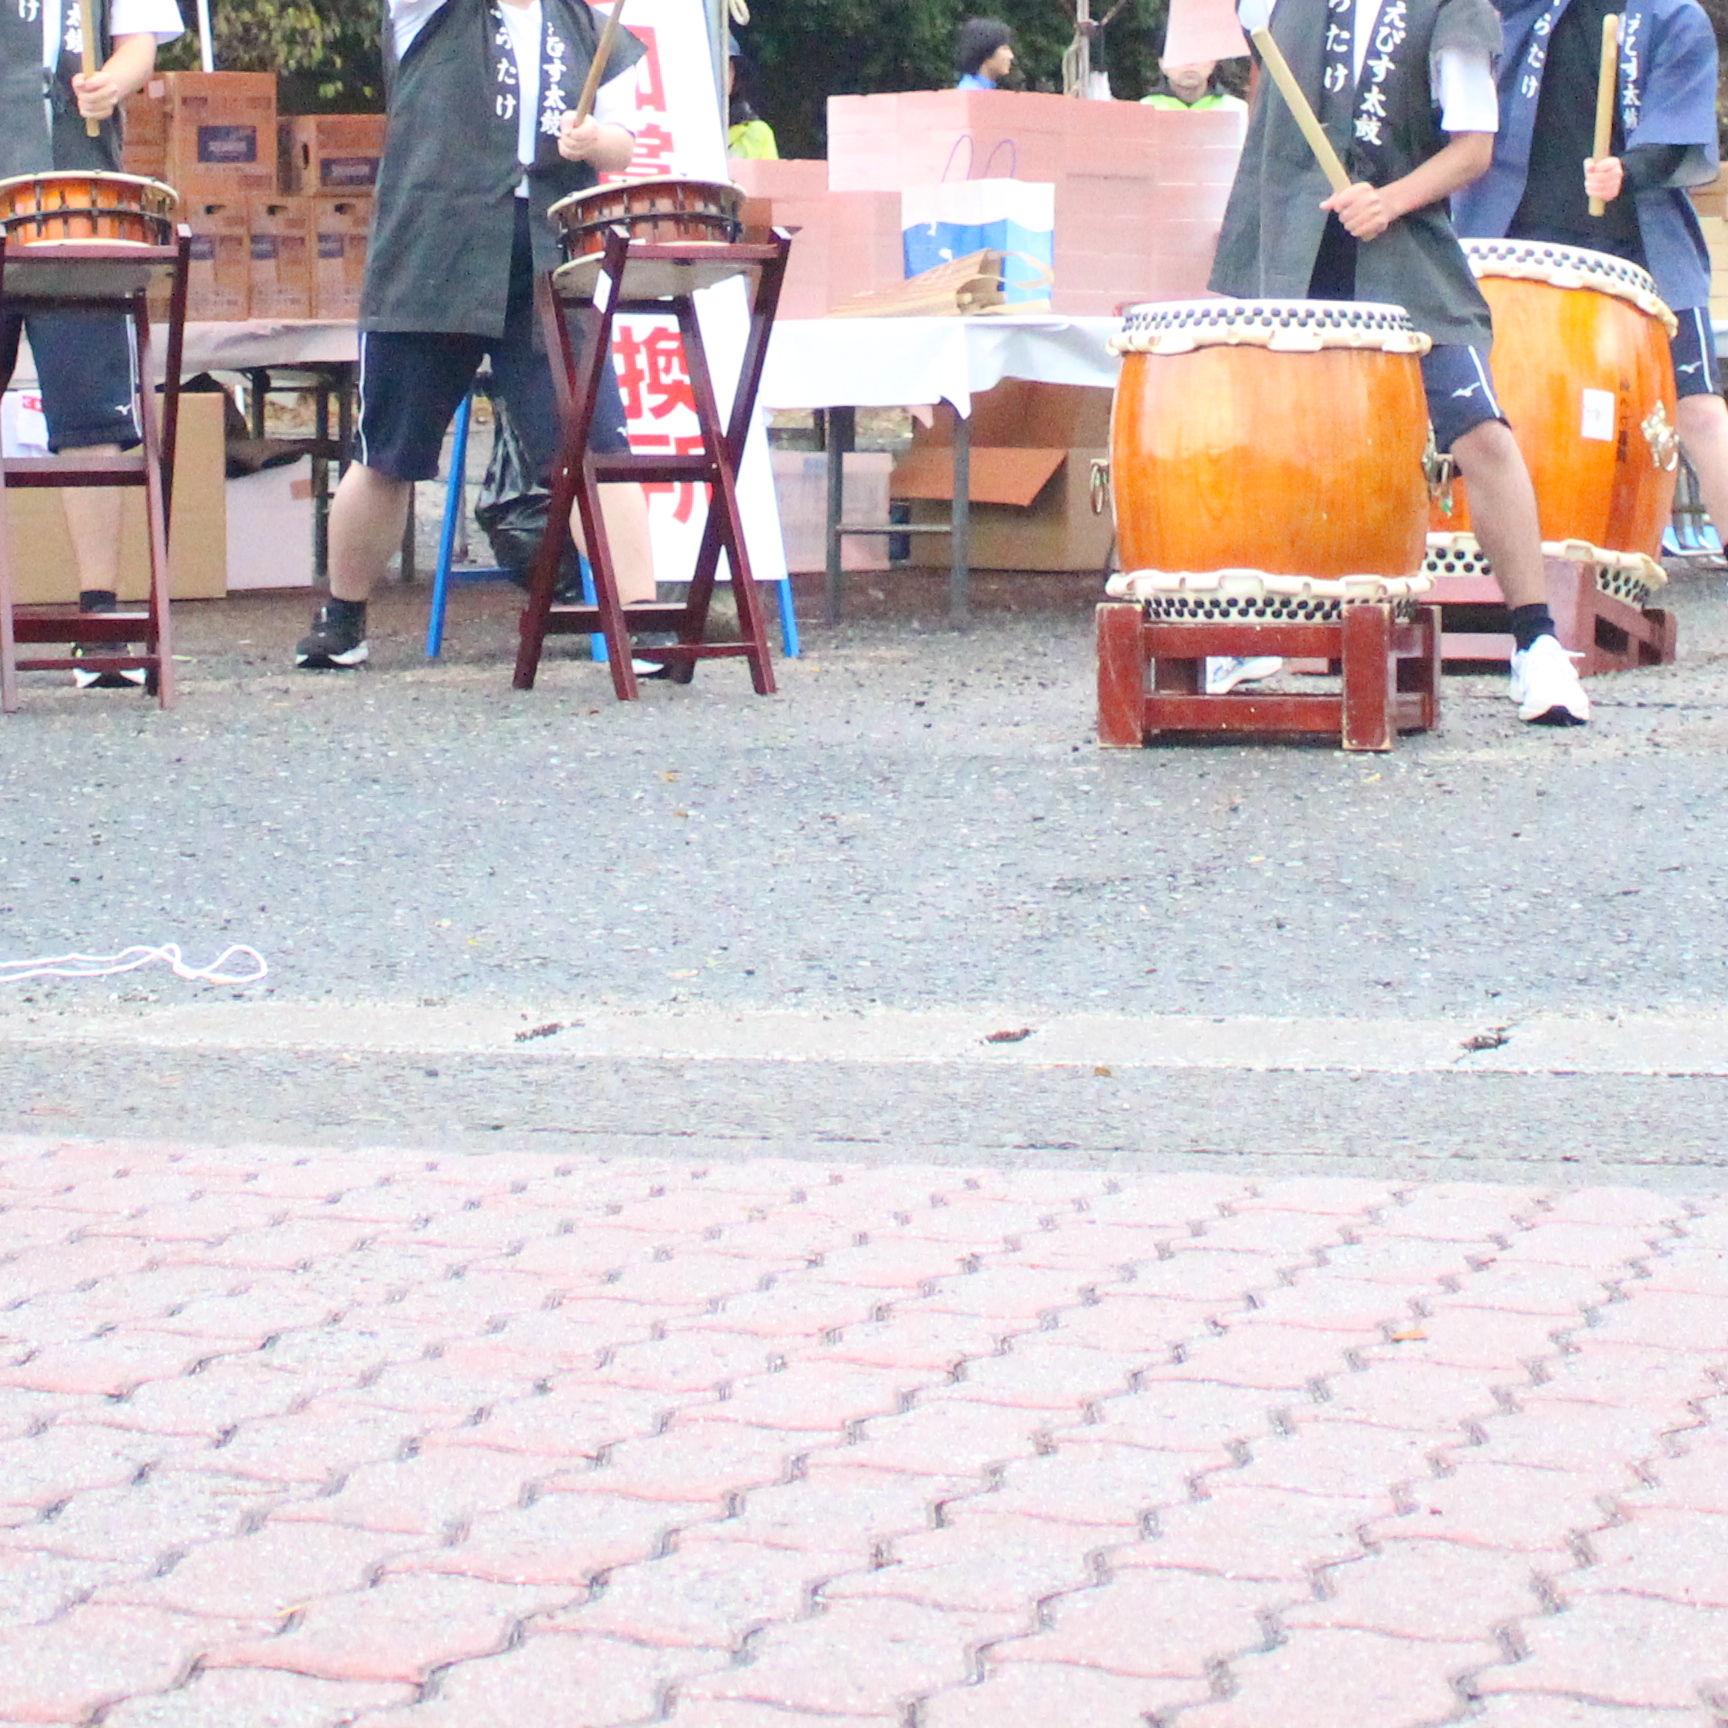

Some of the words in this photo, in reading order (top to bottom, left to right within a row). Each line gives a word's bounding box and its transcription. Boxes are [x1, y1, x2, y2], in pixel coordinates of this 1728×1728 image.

[539, 21, 568, 138] びす太鼓
[1354, 0, 1407, 147] えびす太鼓
